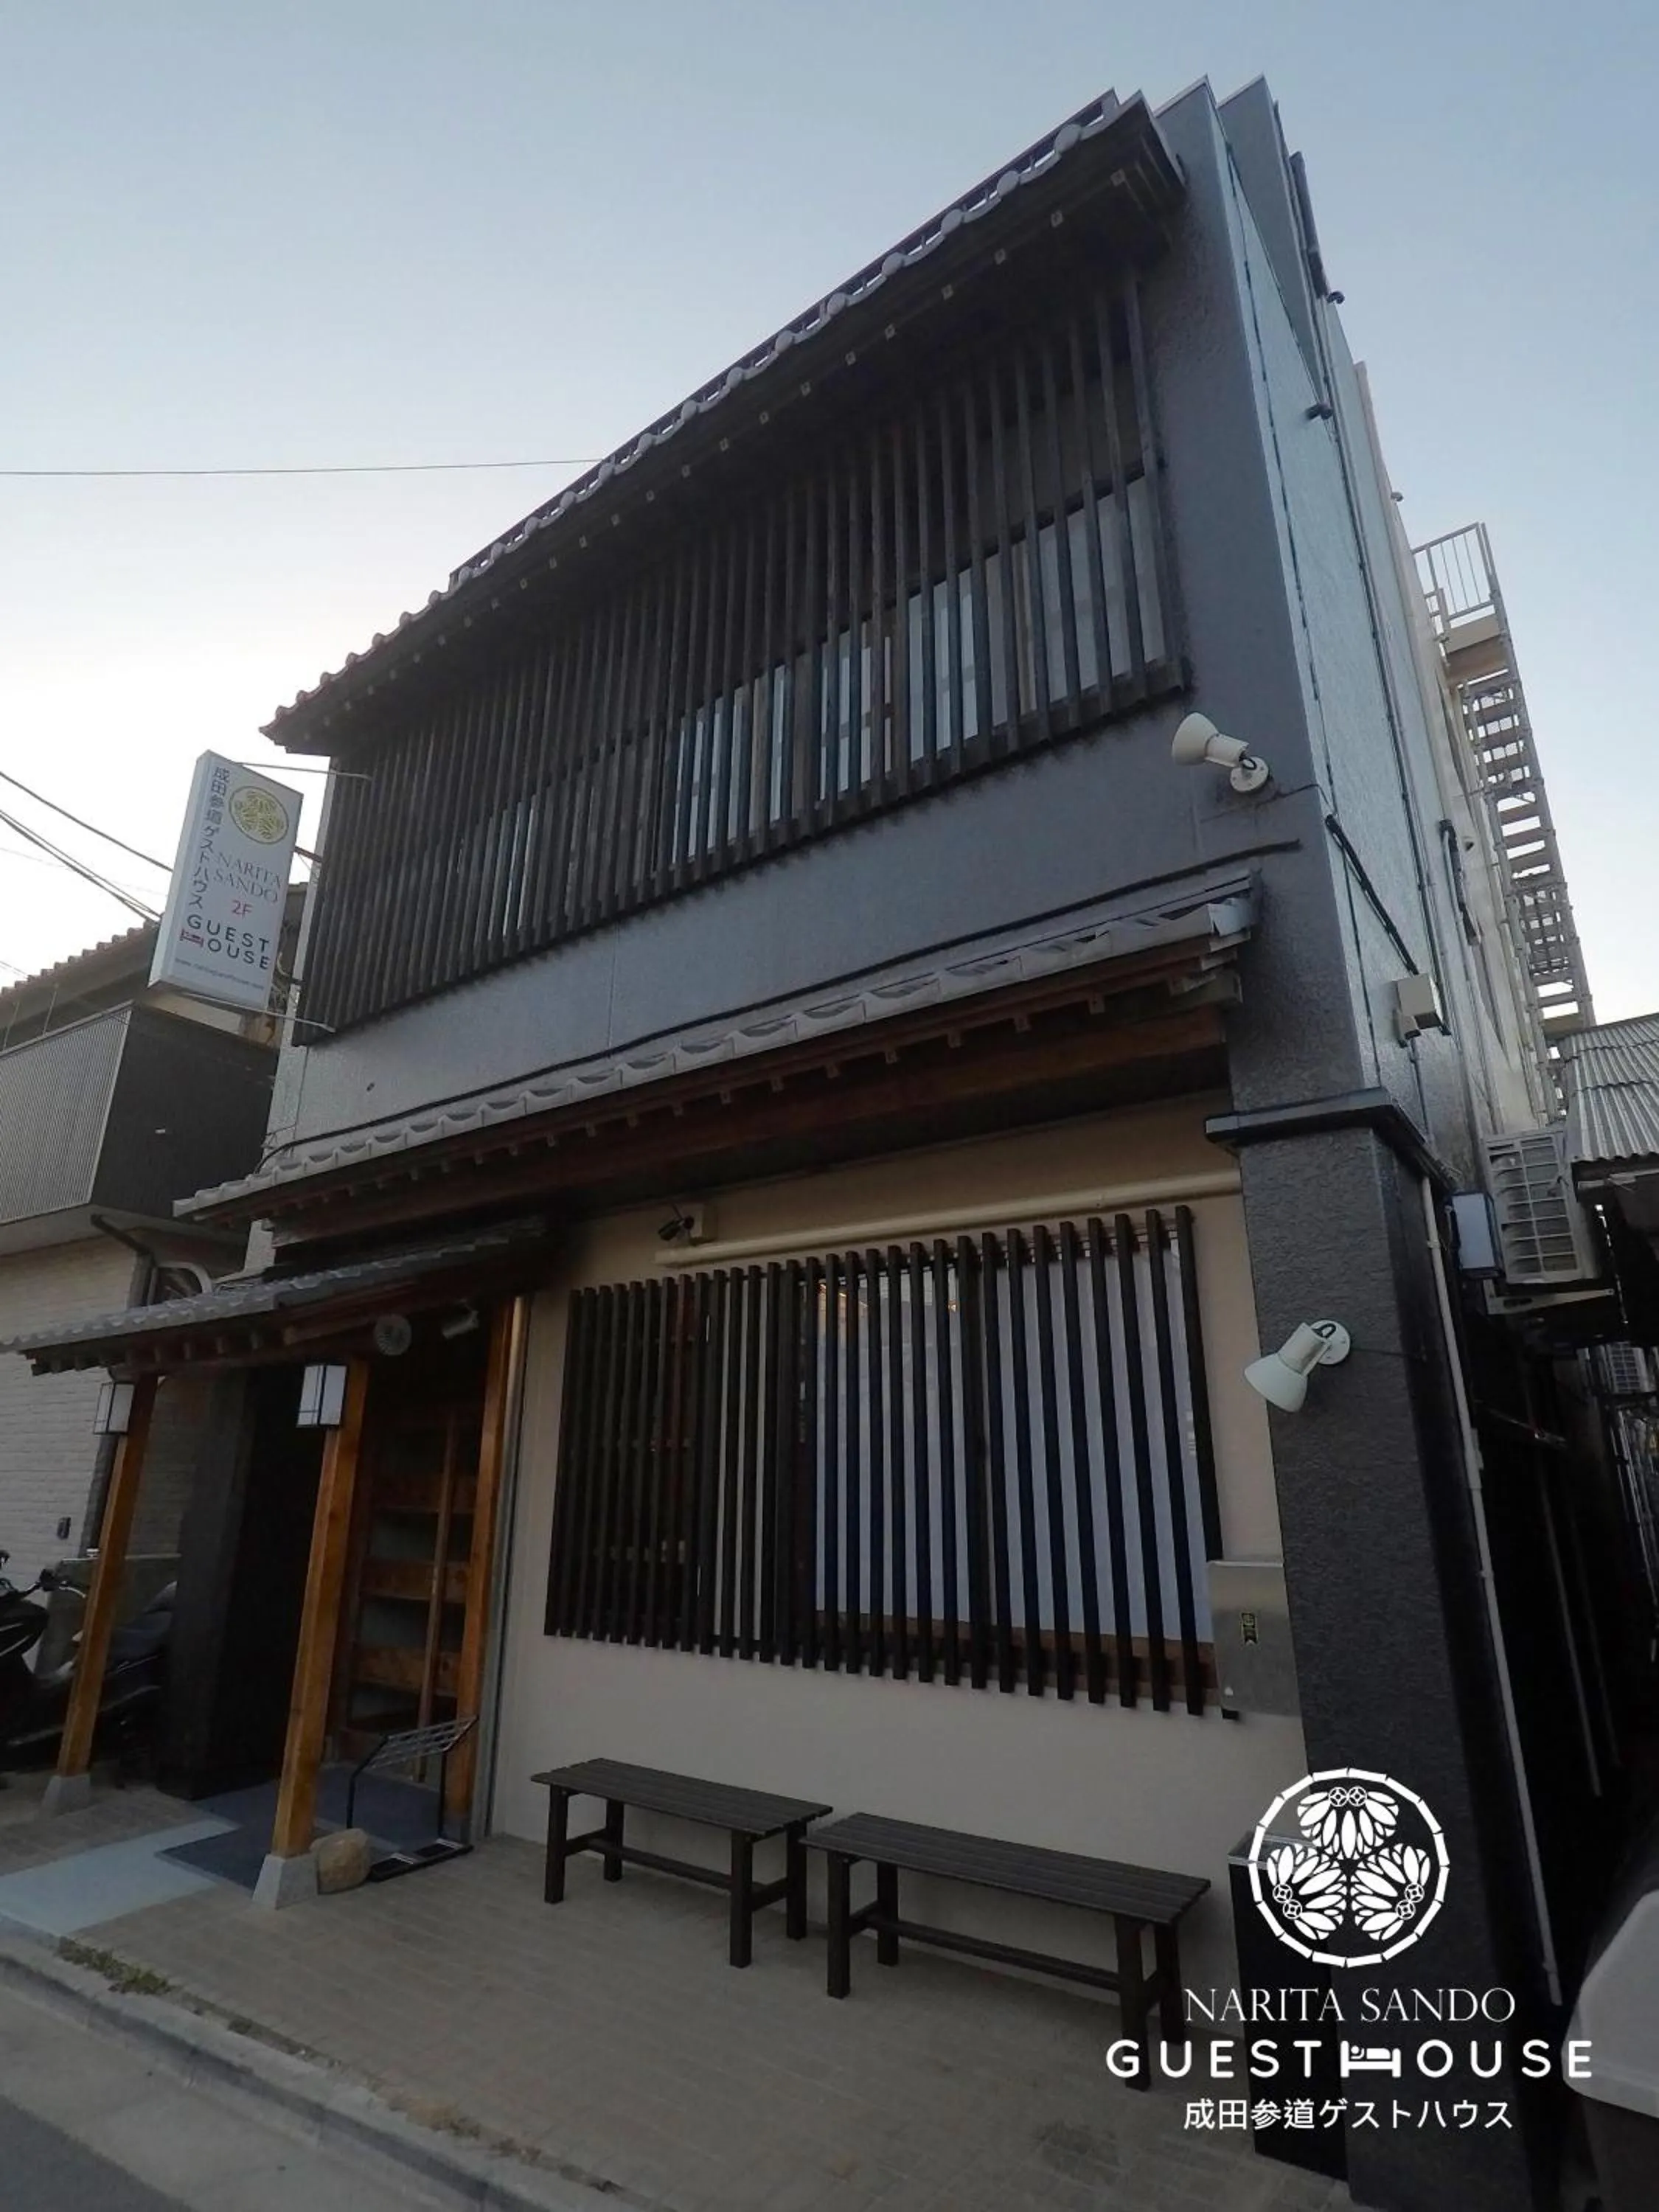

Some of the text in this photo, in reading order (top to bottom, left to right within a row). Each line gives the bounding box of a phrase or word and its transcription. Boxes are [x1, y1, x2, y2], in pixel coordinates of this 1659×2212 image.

[213, 869, 278, 903] SANDO
[215, 852, 281, 890] NARITA
[232, 900, 254, 919] 2F
[187, 914, 270, 953] GUEST
